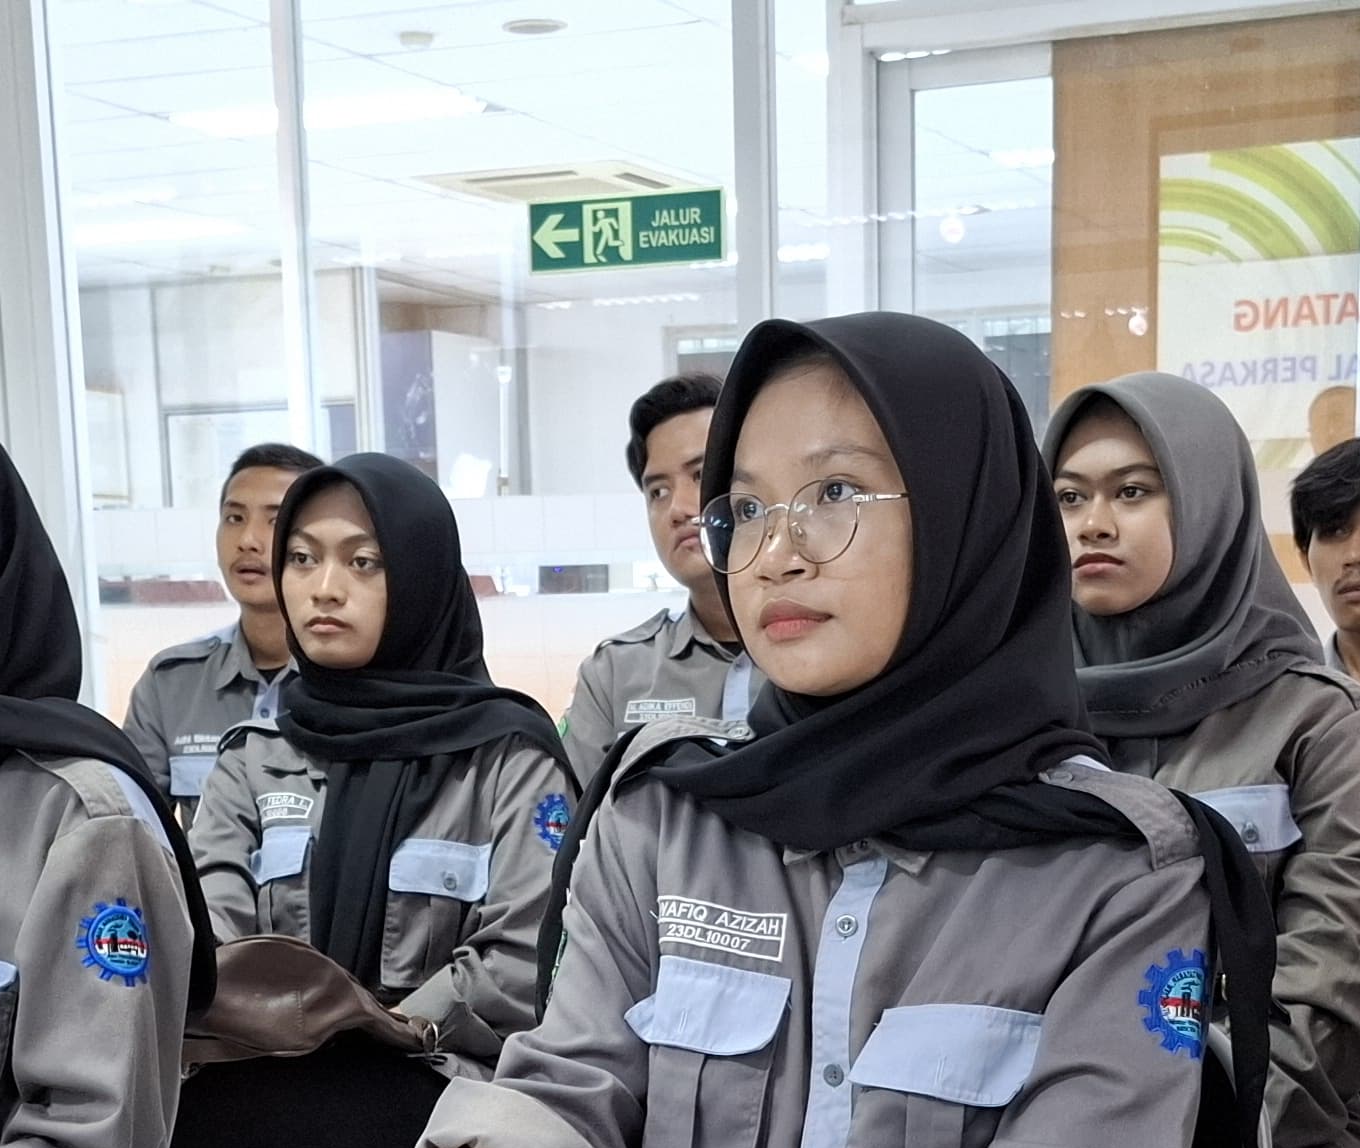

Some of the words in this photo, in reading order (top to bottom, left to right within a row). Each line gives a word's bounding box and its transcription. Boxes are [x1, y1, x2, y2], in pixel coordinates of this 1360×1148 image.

[651, 207, 702, 228] JALUR
[639, 227, 715, 249] EVAKUASI
[715, 911, 780, 936] AZIZAH
[666, 923, 752, 951] 23DL10007
